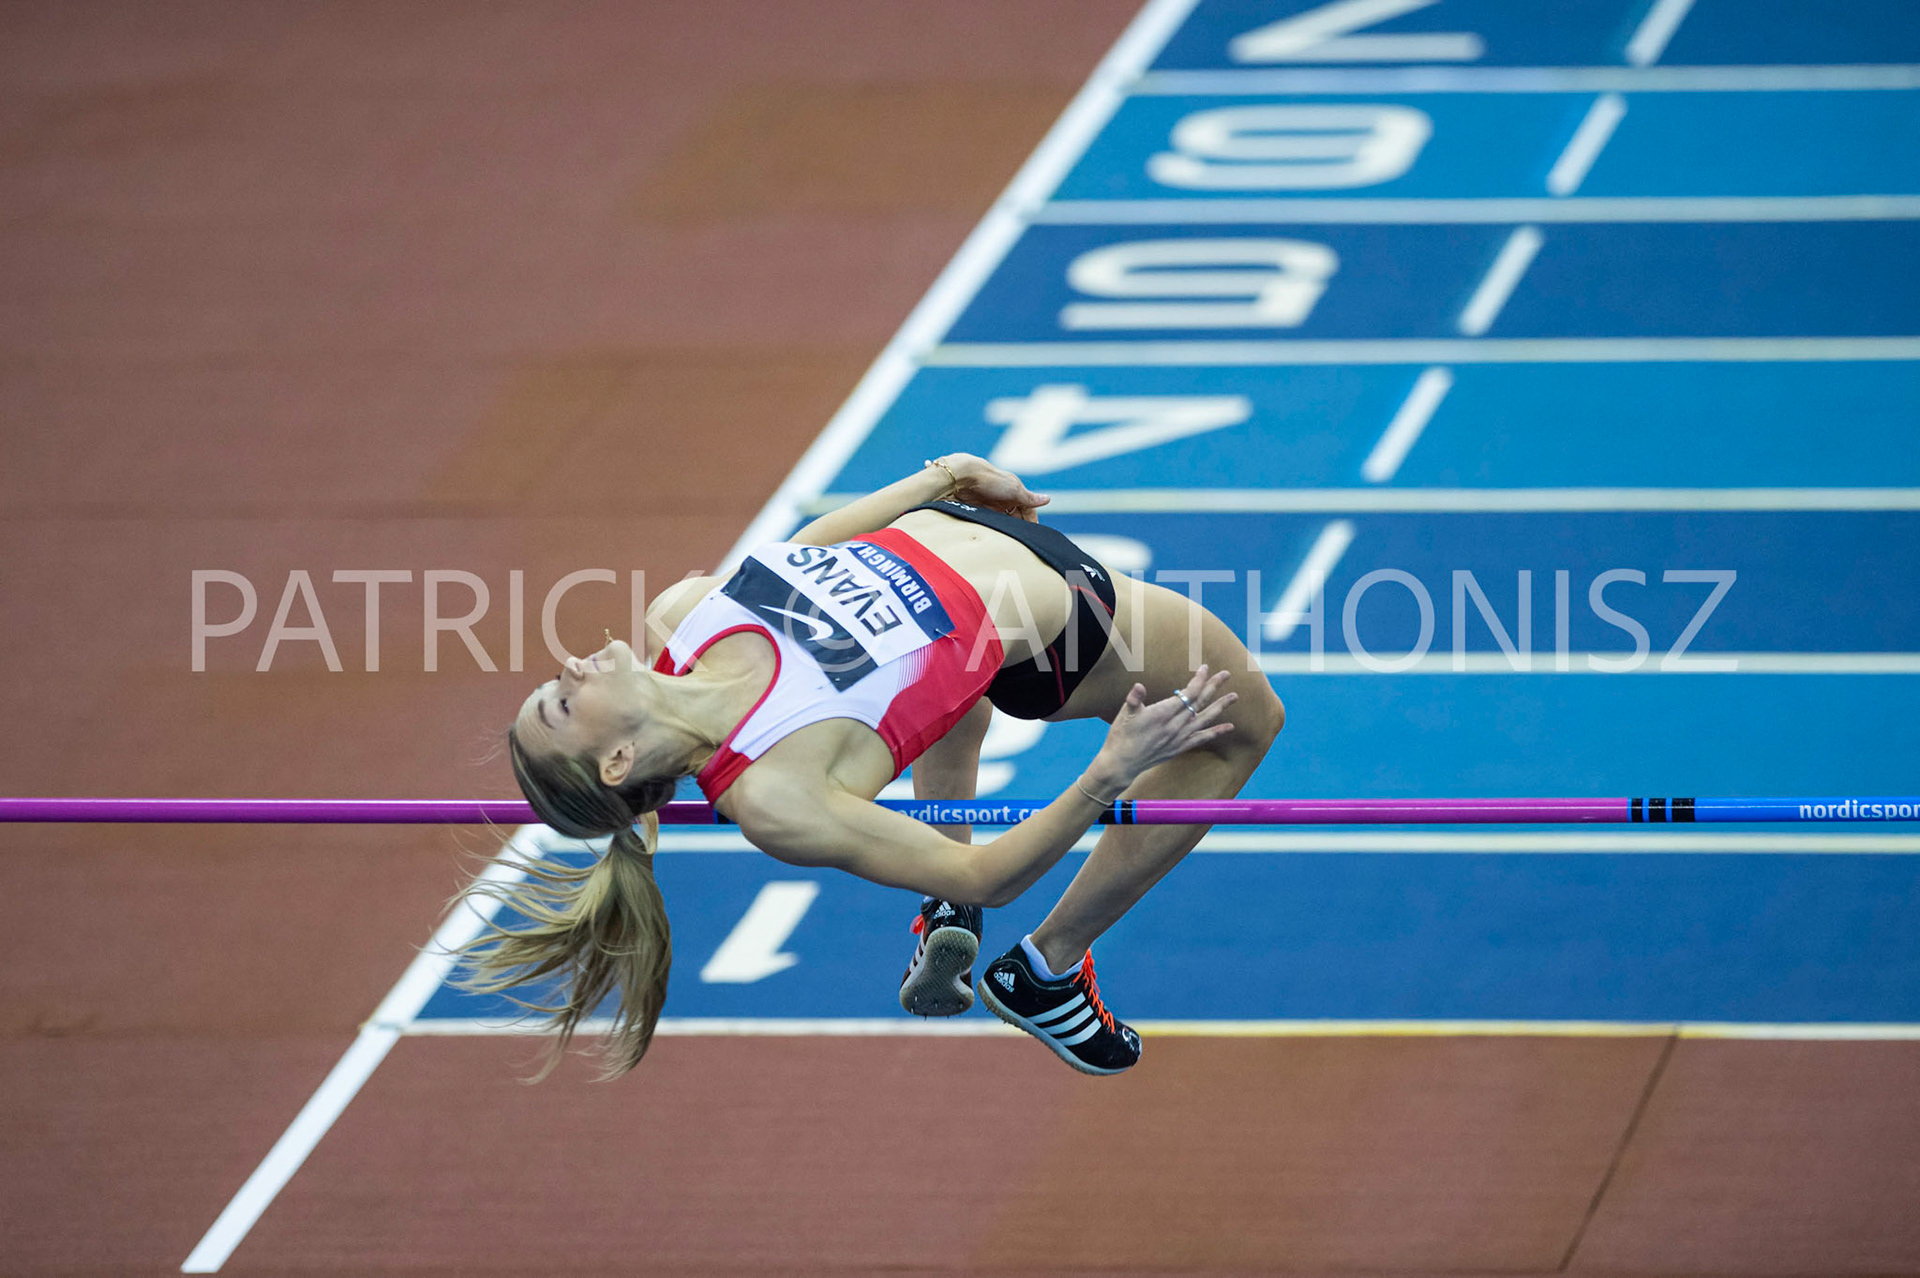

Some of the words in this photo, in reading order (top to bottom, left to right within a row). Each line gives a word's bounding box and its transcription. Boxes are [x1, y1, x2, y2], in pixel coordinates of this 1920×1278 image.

[1058, 237, 1339, 331] 5
[984, 383, 1253, 476] 4
[786, 546, 903, 637] EVANS
[699, 881, 819, 984] 1
[993, 971, 1015, 994] adidas
